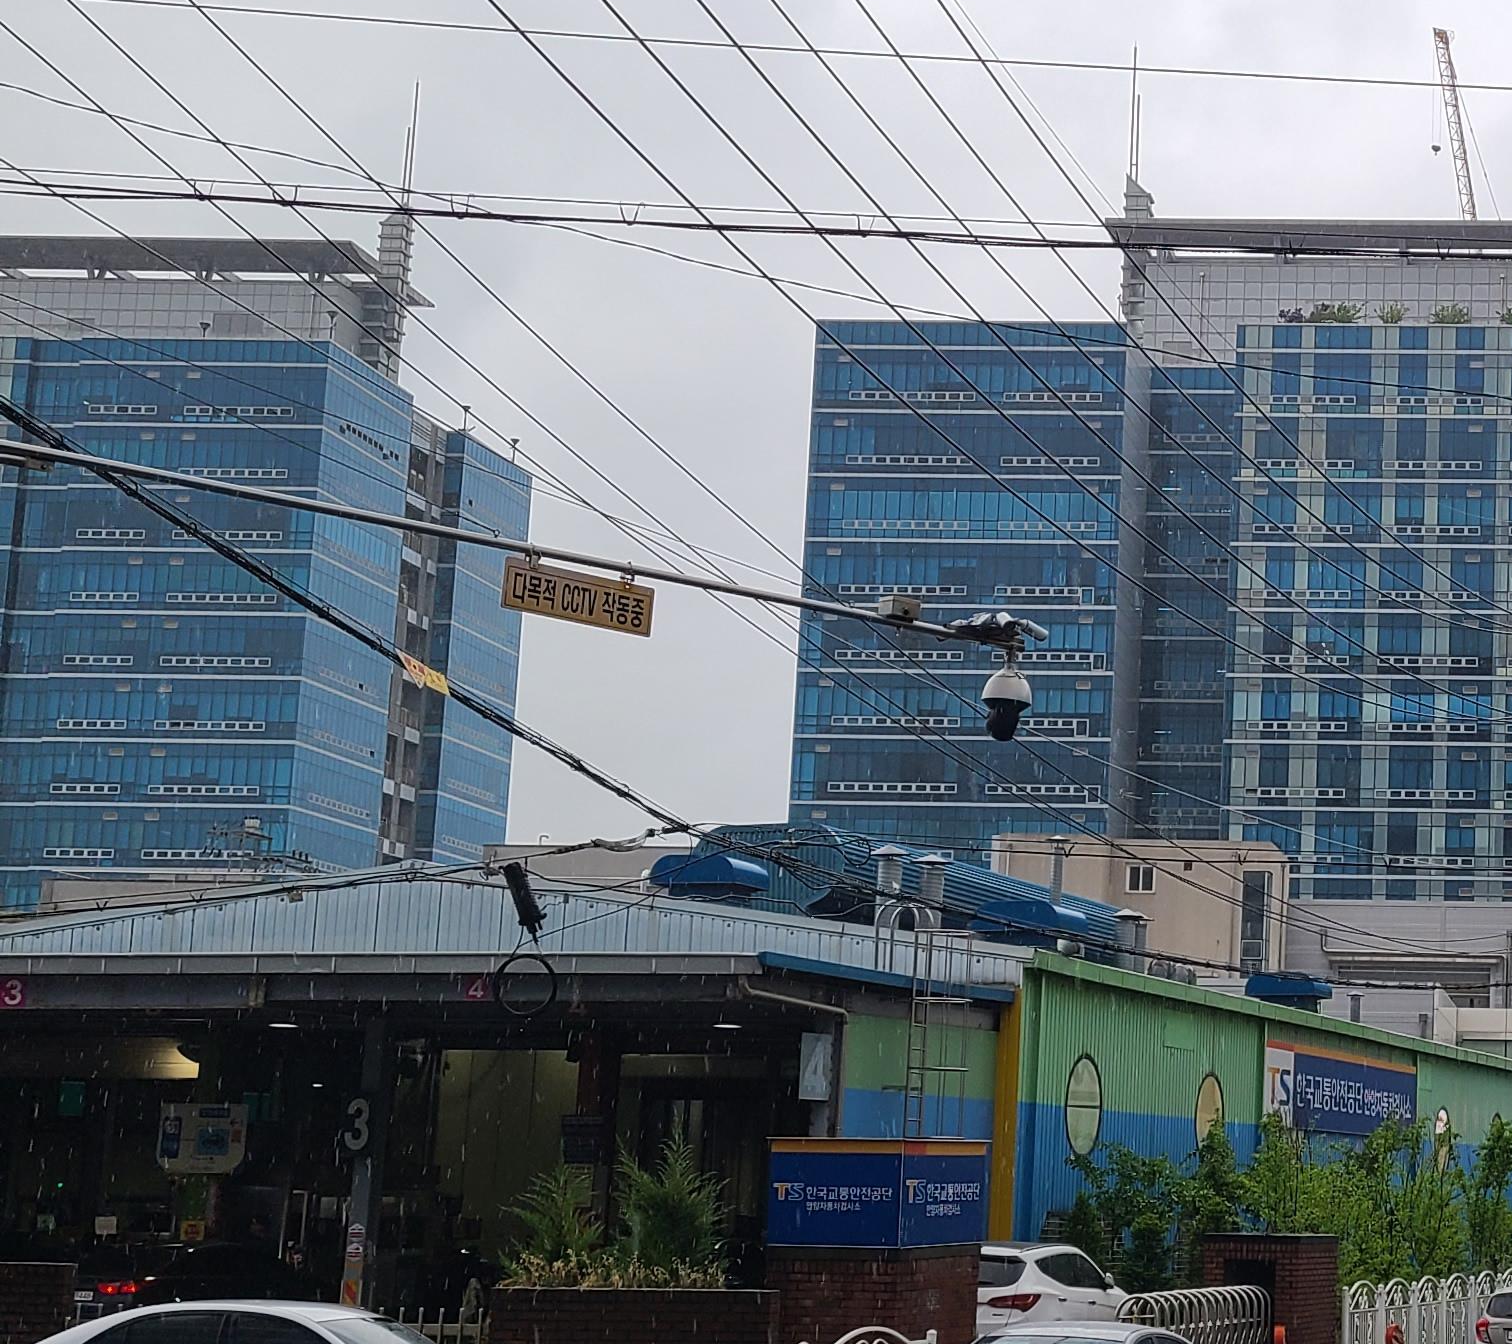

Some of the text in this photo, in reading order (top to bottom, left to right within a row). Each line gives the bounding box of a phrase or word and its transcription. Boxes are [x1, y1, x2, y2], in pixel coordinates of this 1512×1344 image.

[512, 571, 644, 628] 다목적 CCTV 작동중
[4, 979, 22, 1005] 3
[468, 979, 484, 998] 4
[1268, 1067, 1291, 1106] TS
[1296, 1073, 1363, 1115] 한국교통안전공단
[344, 1098, 370, 1150] 3
[773, 1182, 804, 1201] TS
[905, 1179, 926, 1203] TS
